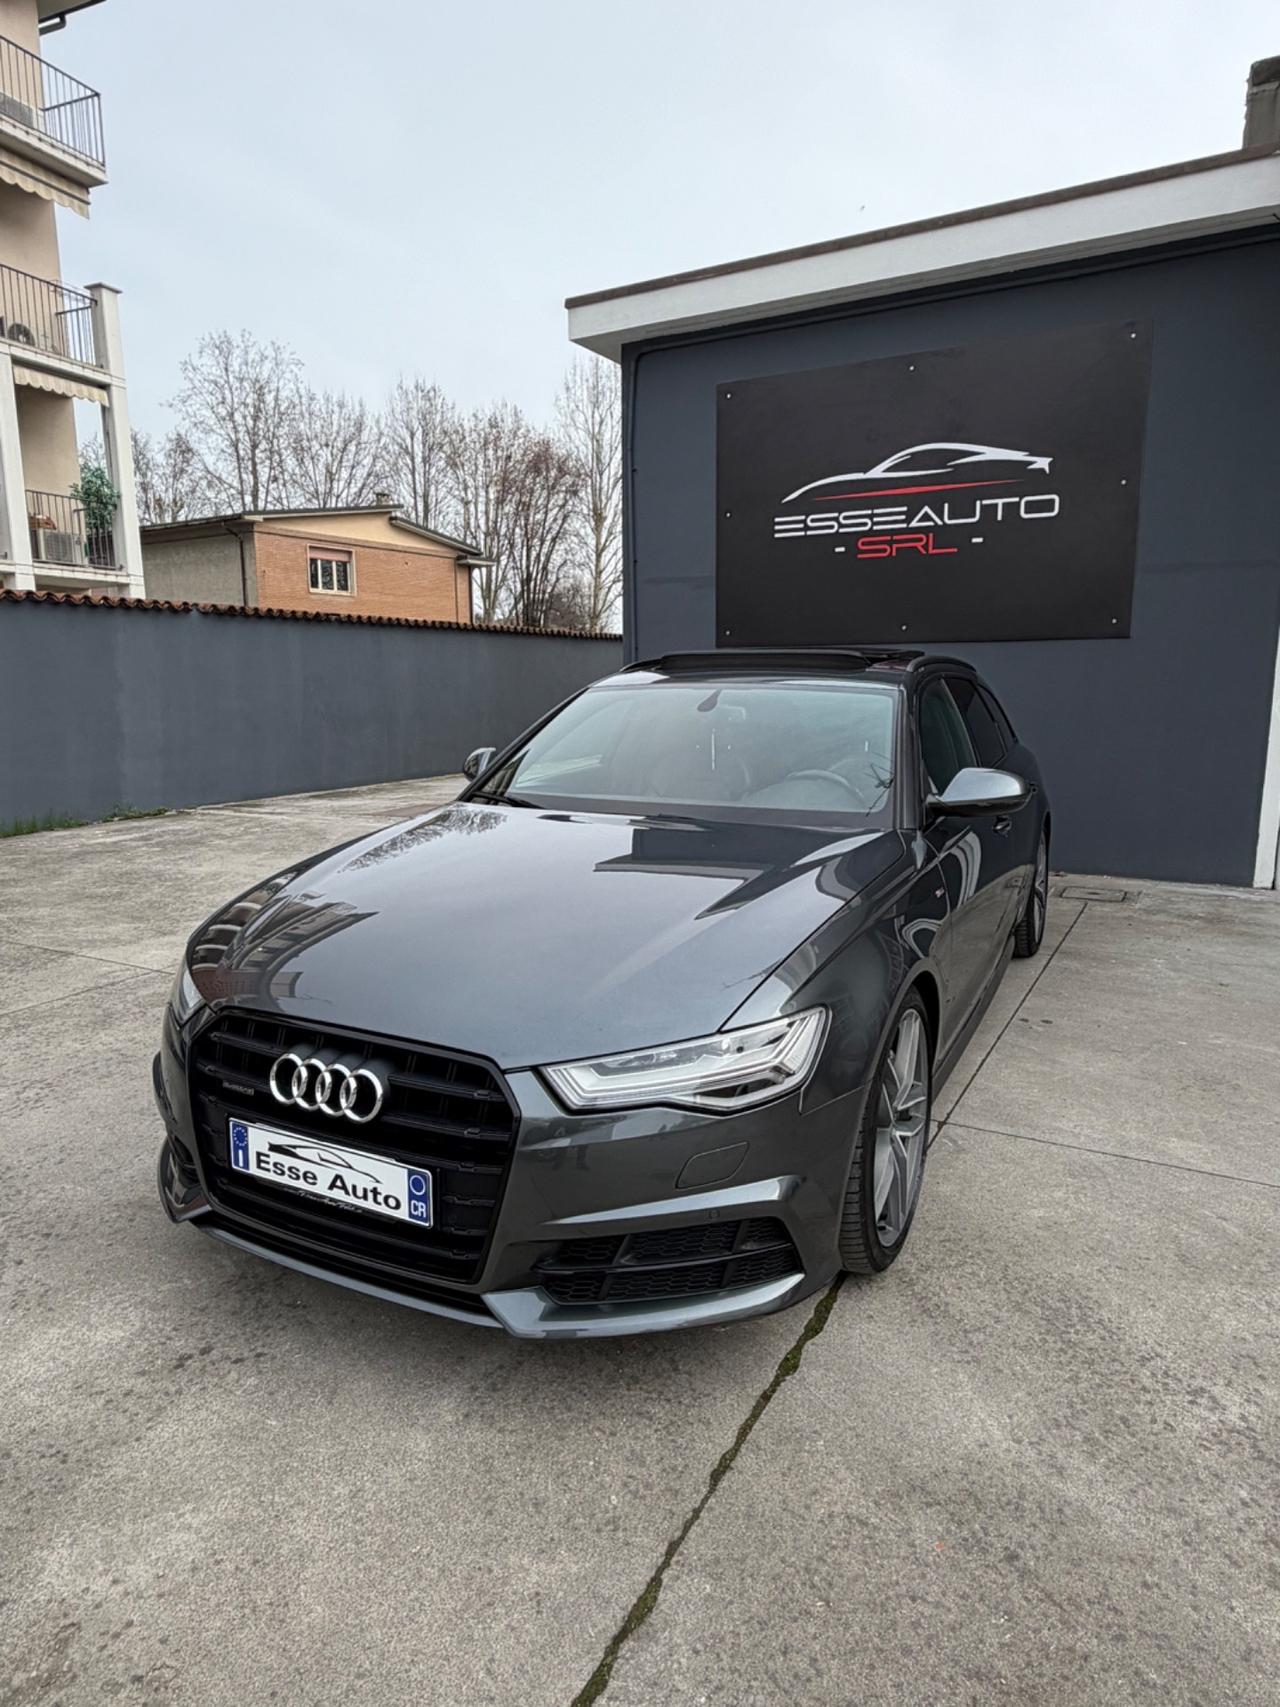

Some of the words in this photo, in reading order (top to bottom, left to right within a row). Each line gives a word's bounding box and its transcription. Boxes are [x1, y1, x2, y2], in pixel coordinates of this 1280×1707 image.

[774, 494, 1060, 538] ESSEAUTO
[857, 533, 958, 559] SRL
[255, 1151, 318, 1186] Esse
[327, 1173, 401, 1211] Auto
[411, 1200, 426, 1218] CR
